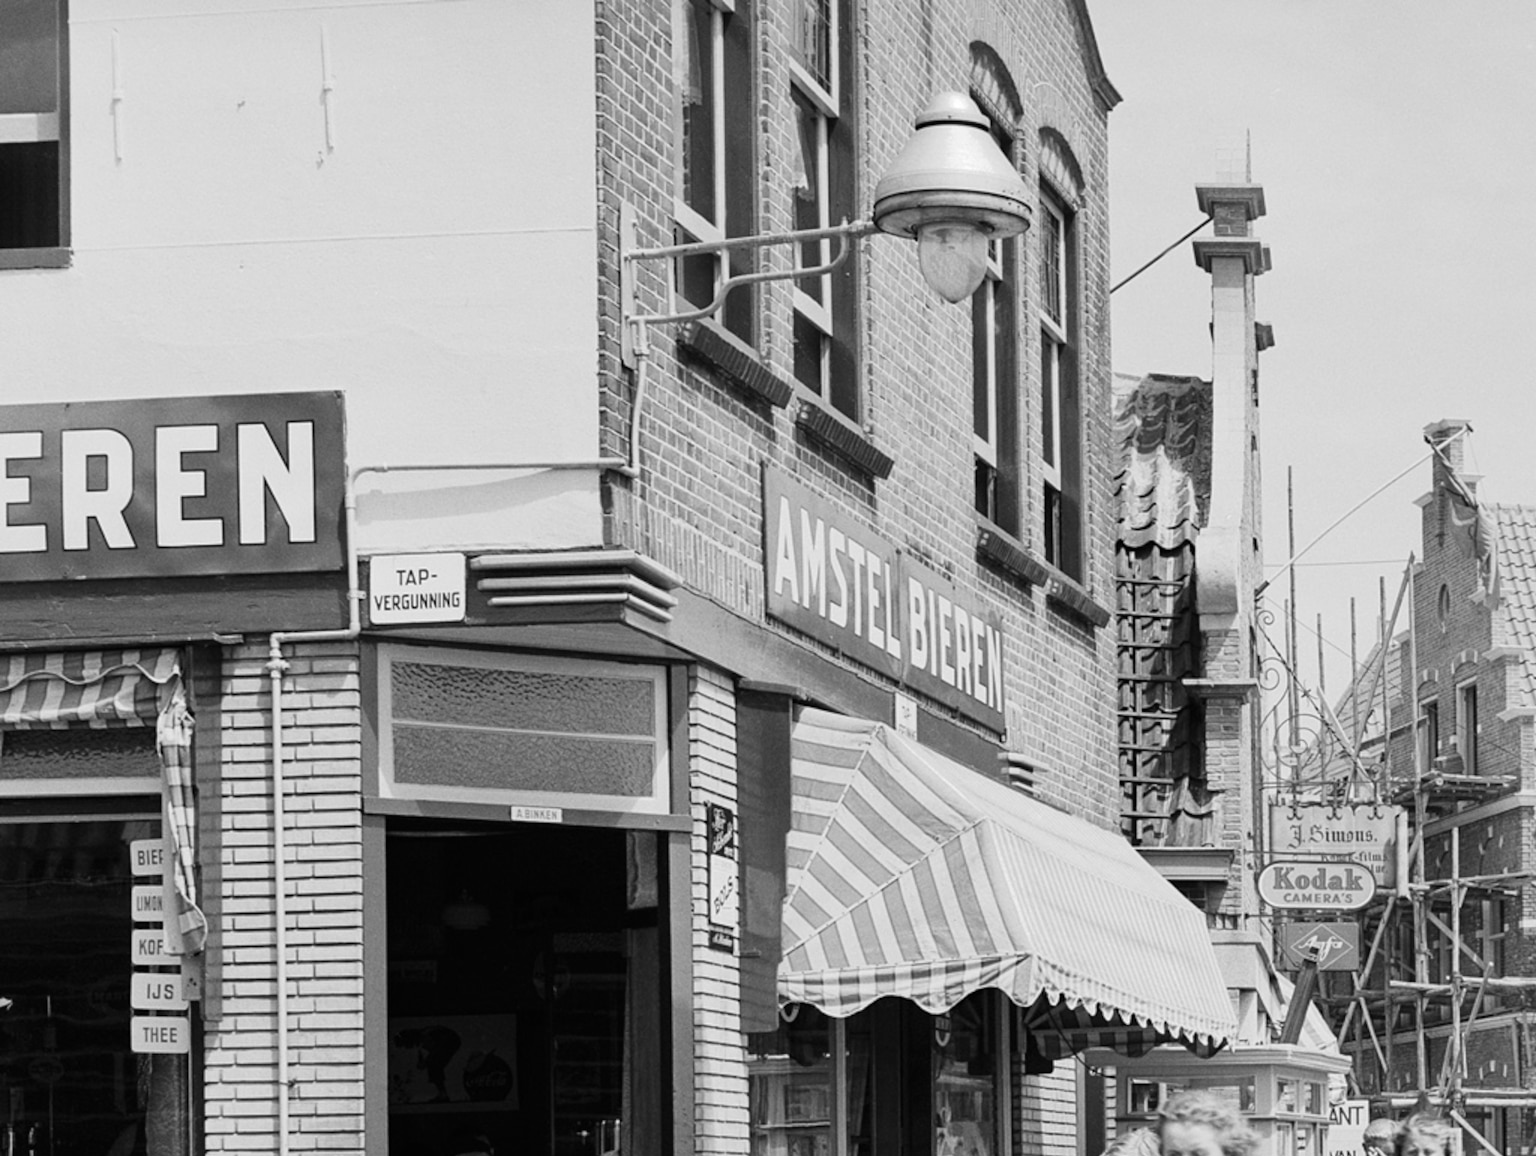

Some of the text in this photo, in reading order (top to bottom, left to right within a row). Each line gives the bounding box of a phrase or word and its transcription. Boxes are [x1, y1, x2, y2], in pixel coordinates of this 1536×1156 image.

[0, 420, 318, 553] EREN
[396, 569, 438, 586] TAP-
[374, 591, 460, 611] VERGUNNING
[775, 495, 1003, 714] AMSTEL BIEREN
[1272, 866, 1363, 891] Kodak
[1283, 893, 1353, 904] CAMERA'S
[147, 983, 175, 1000] IJS
[143, 1027, 178, 1043] THEE
